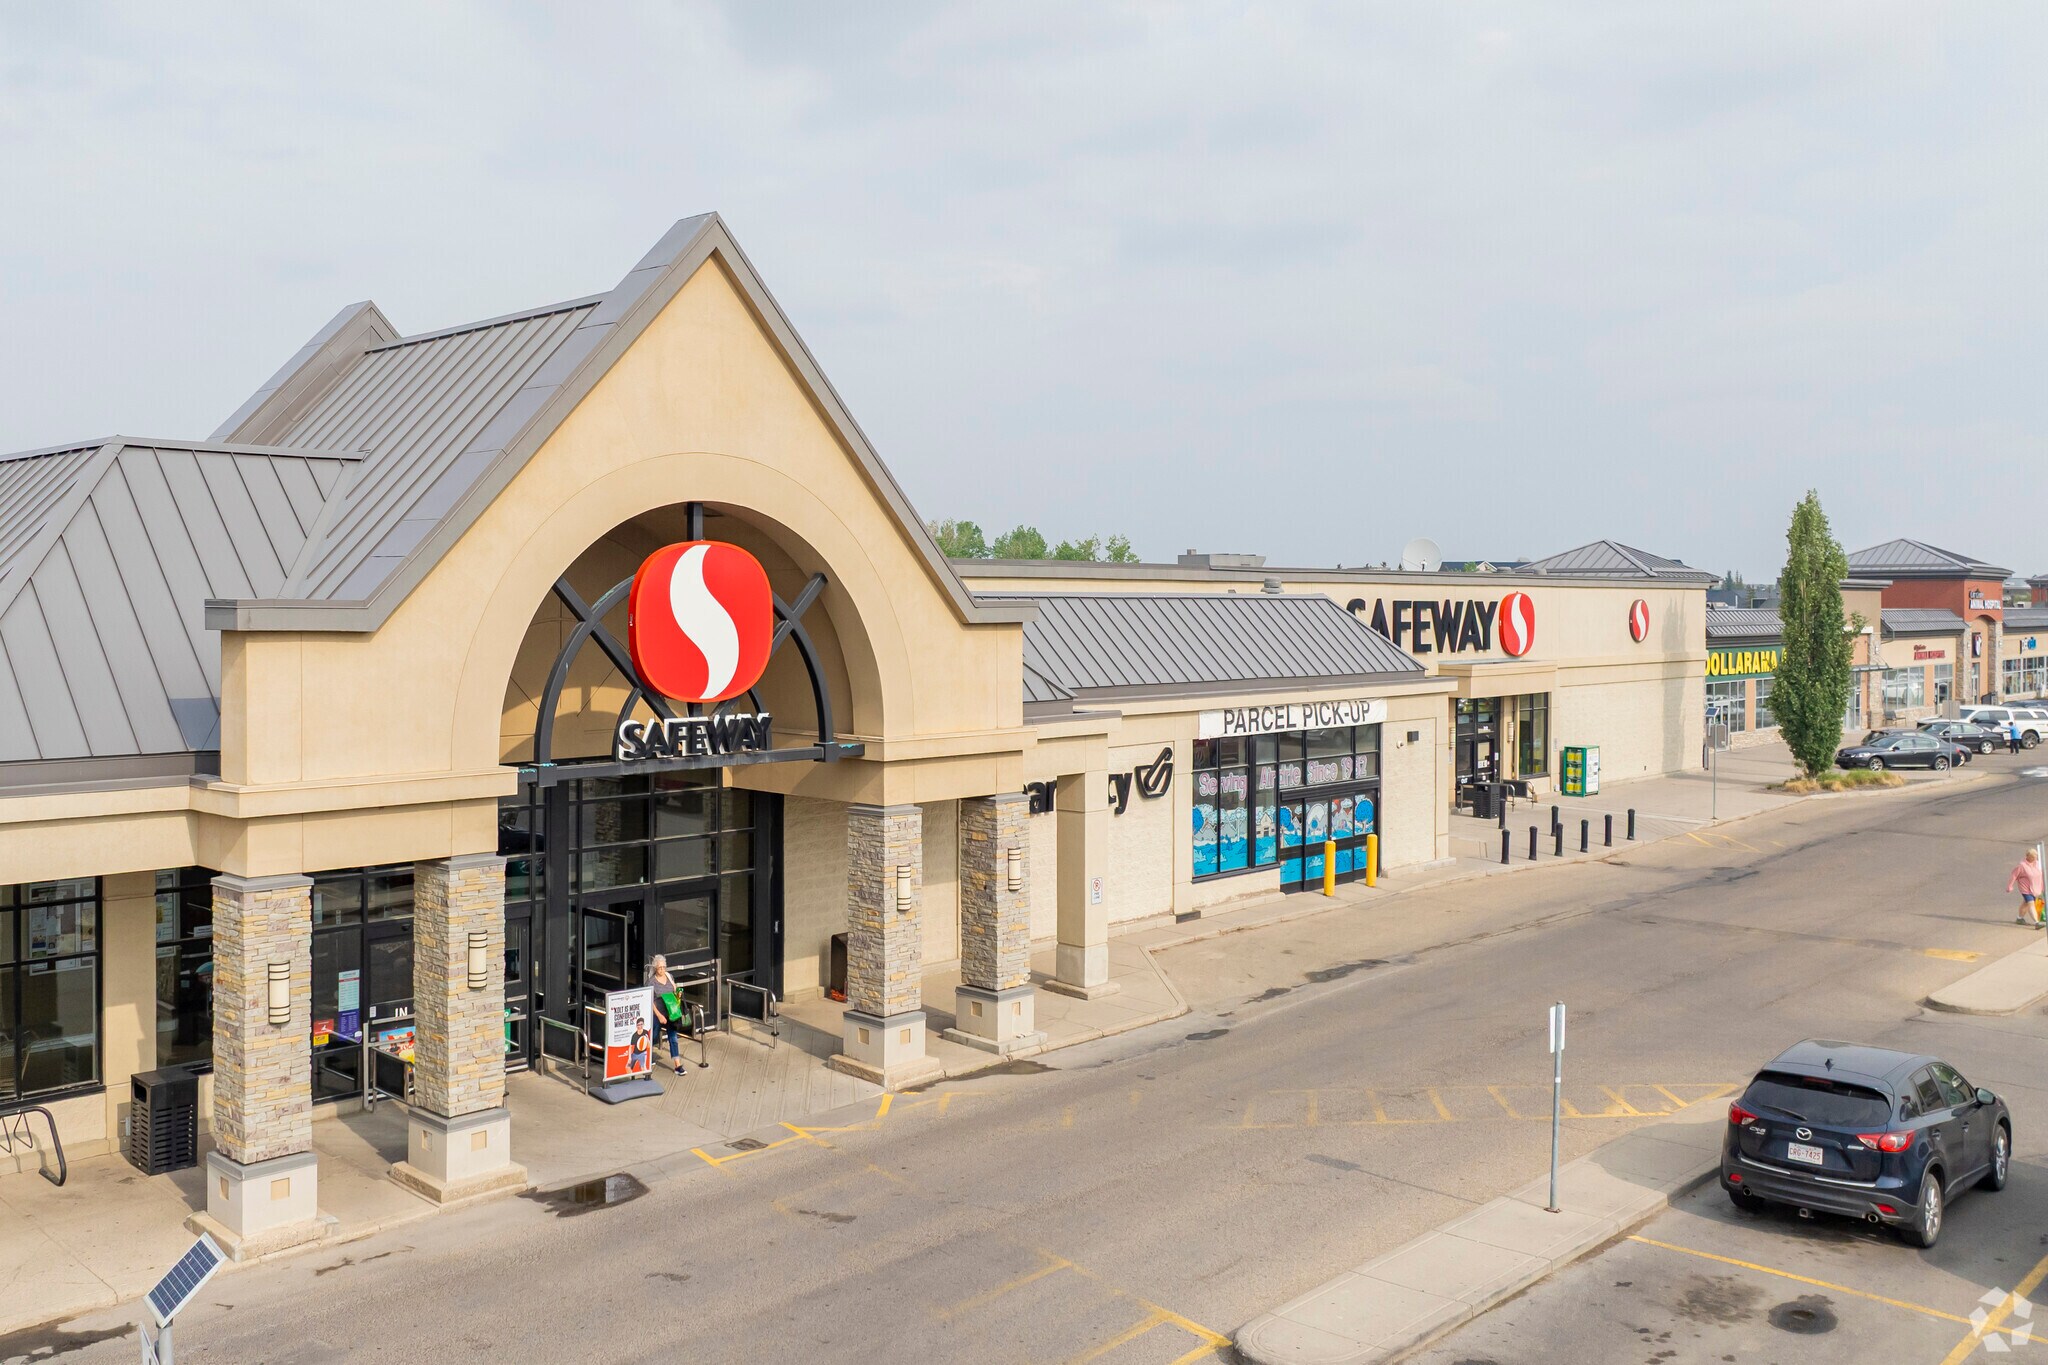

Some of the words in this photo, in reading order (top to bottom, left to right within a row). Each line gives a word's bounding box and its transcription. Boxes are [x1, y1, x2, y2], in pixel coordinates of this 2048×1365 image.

[1223, 705, 1297, 734] PARCEL
[1303, 700, 1370, 727] PICK-UP
[619, 712, 773, 761] SAFEWAY
[1307, 760, 1338, 783] Since
[394, 1006, 408, 1018] IN
[614, 1011, 636, 1021] CONFIDENT
